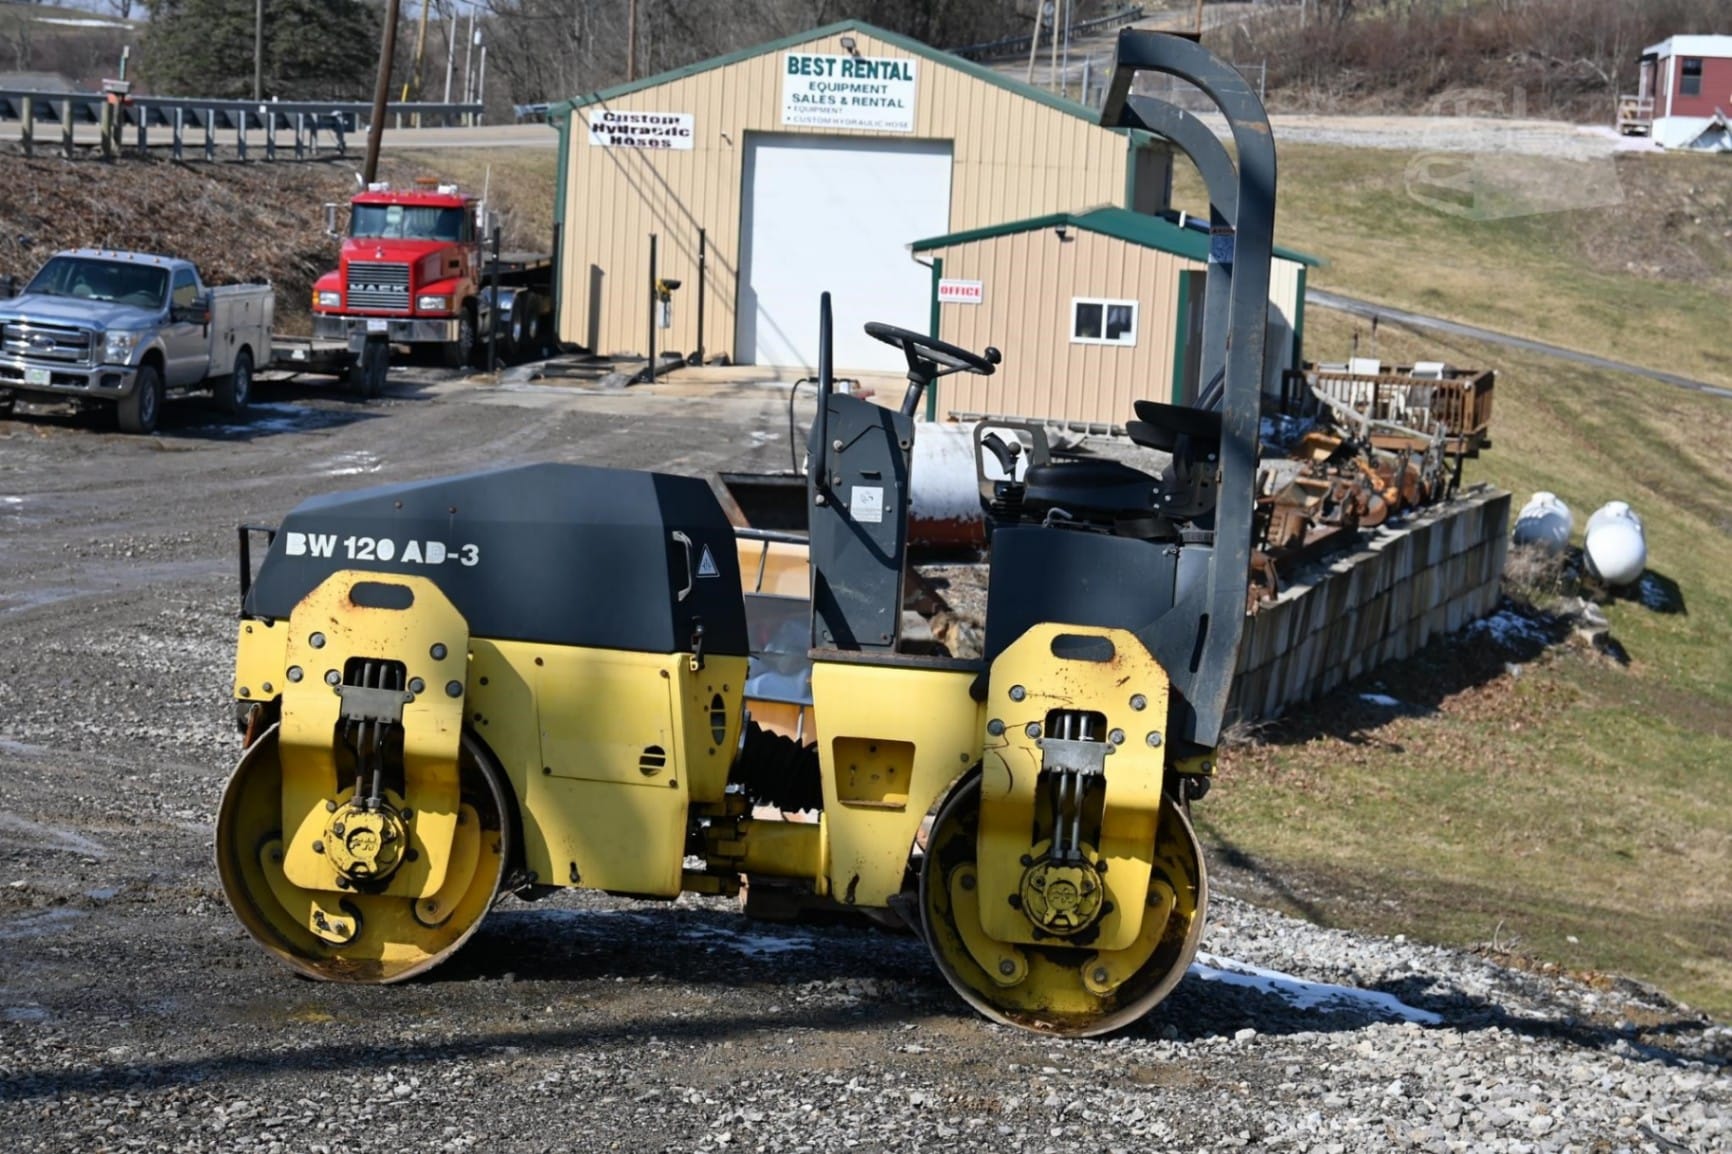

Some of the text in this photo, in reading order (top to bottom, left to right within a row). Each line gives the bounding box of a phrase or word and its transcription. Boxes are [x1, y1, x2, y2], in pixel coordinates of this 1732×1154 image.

[787, 56, 913, 81] BEST RENTAL
[809, 81, 889, 94] EQUIPMENT
[792, 93, 905, 108] SALES & RENTAL
[793, 106, 843, 114] EQUIPMENT
[603, 112, 681, 125] Custom
[349, 283, 406, 293] MACK
[940, 285, 980, 297] OFFICE
[285, 532, 480, 567] BW 120 AD-3
